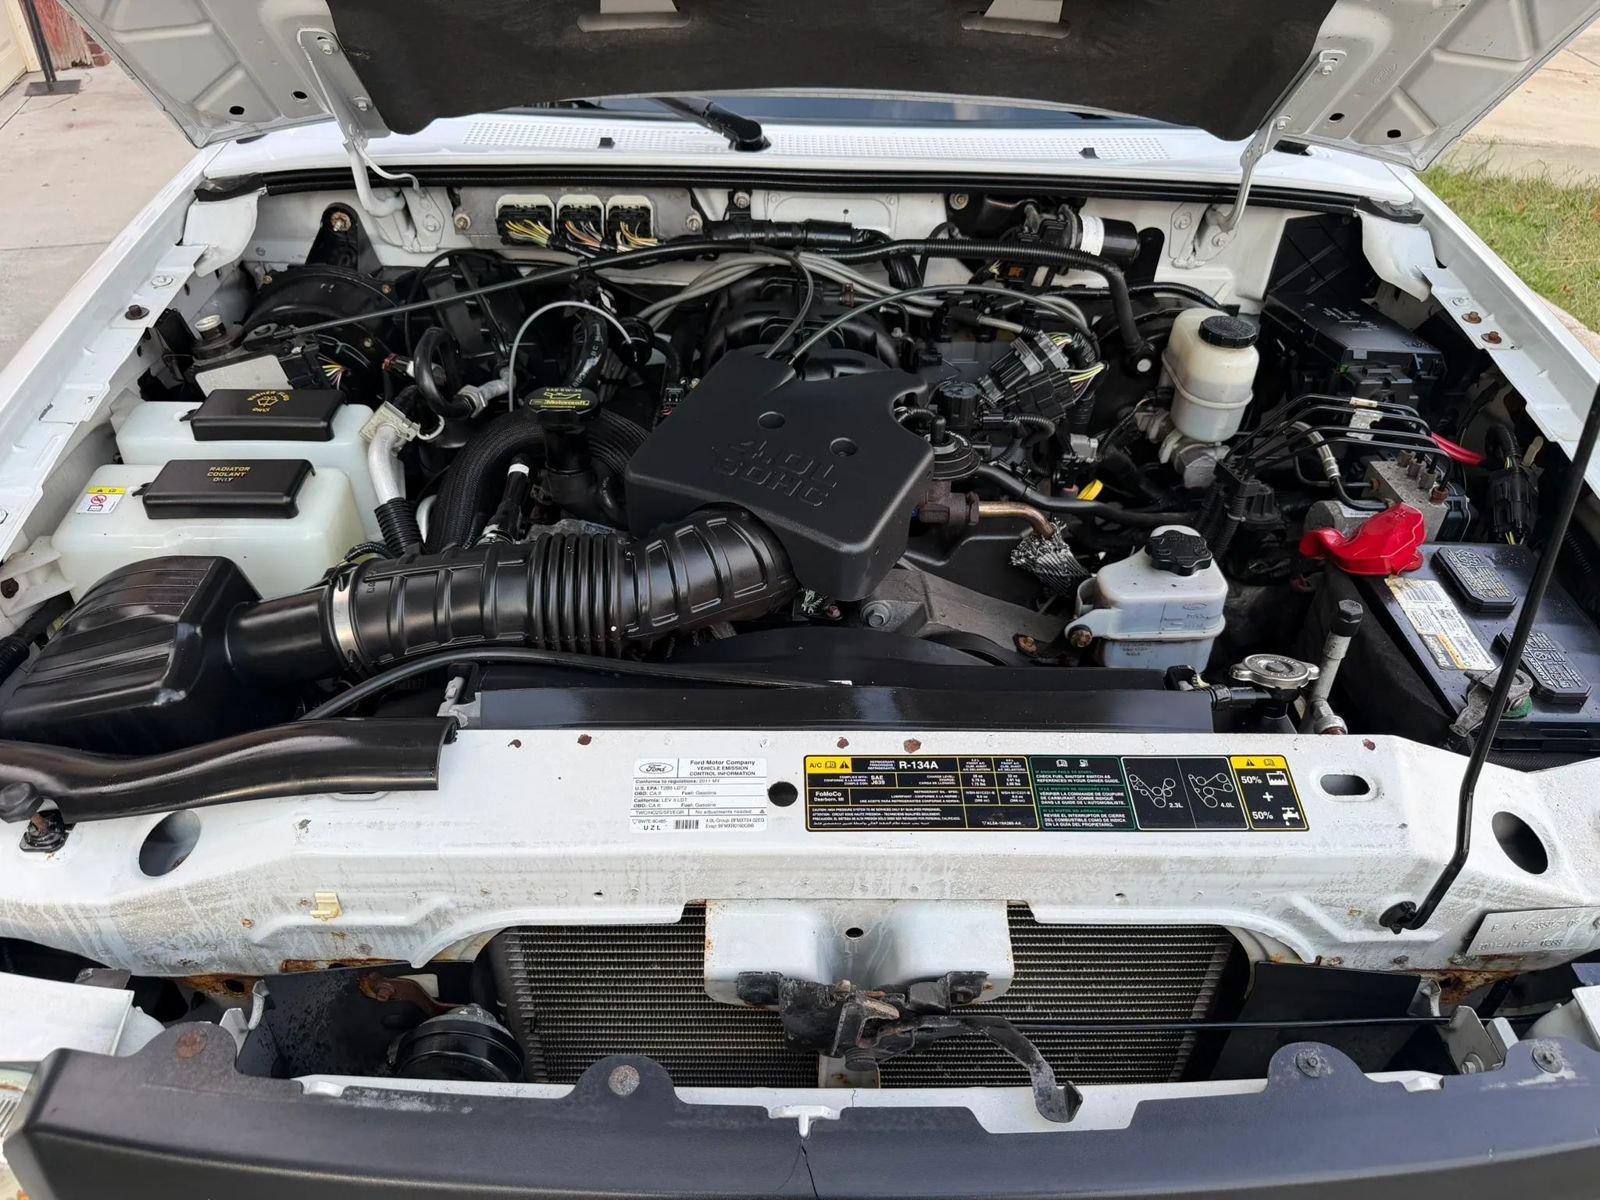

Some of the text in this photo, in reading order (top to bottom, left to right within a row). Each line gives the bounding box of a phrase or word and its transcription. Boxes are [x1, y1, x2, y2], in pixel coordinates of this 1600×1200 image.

[899, 761, 938, 769] R-134A
[1241, 776, 1263, 784] 50%
[1252, 811, 1274, 820] 50%
